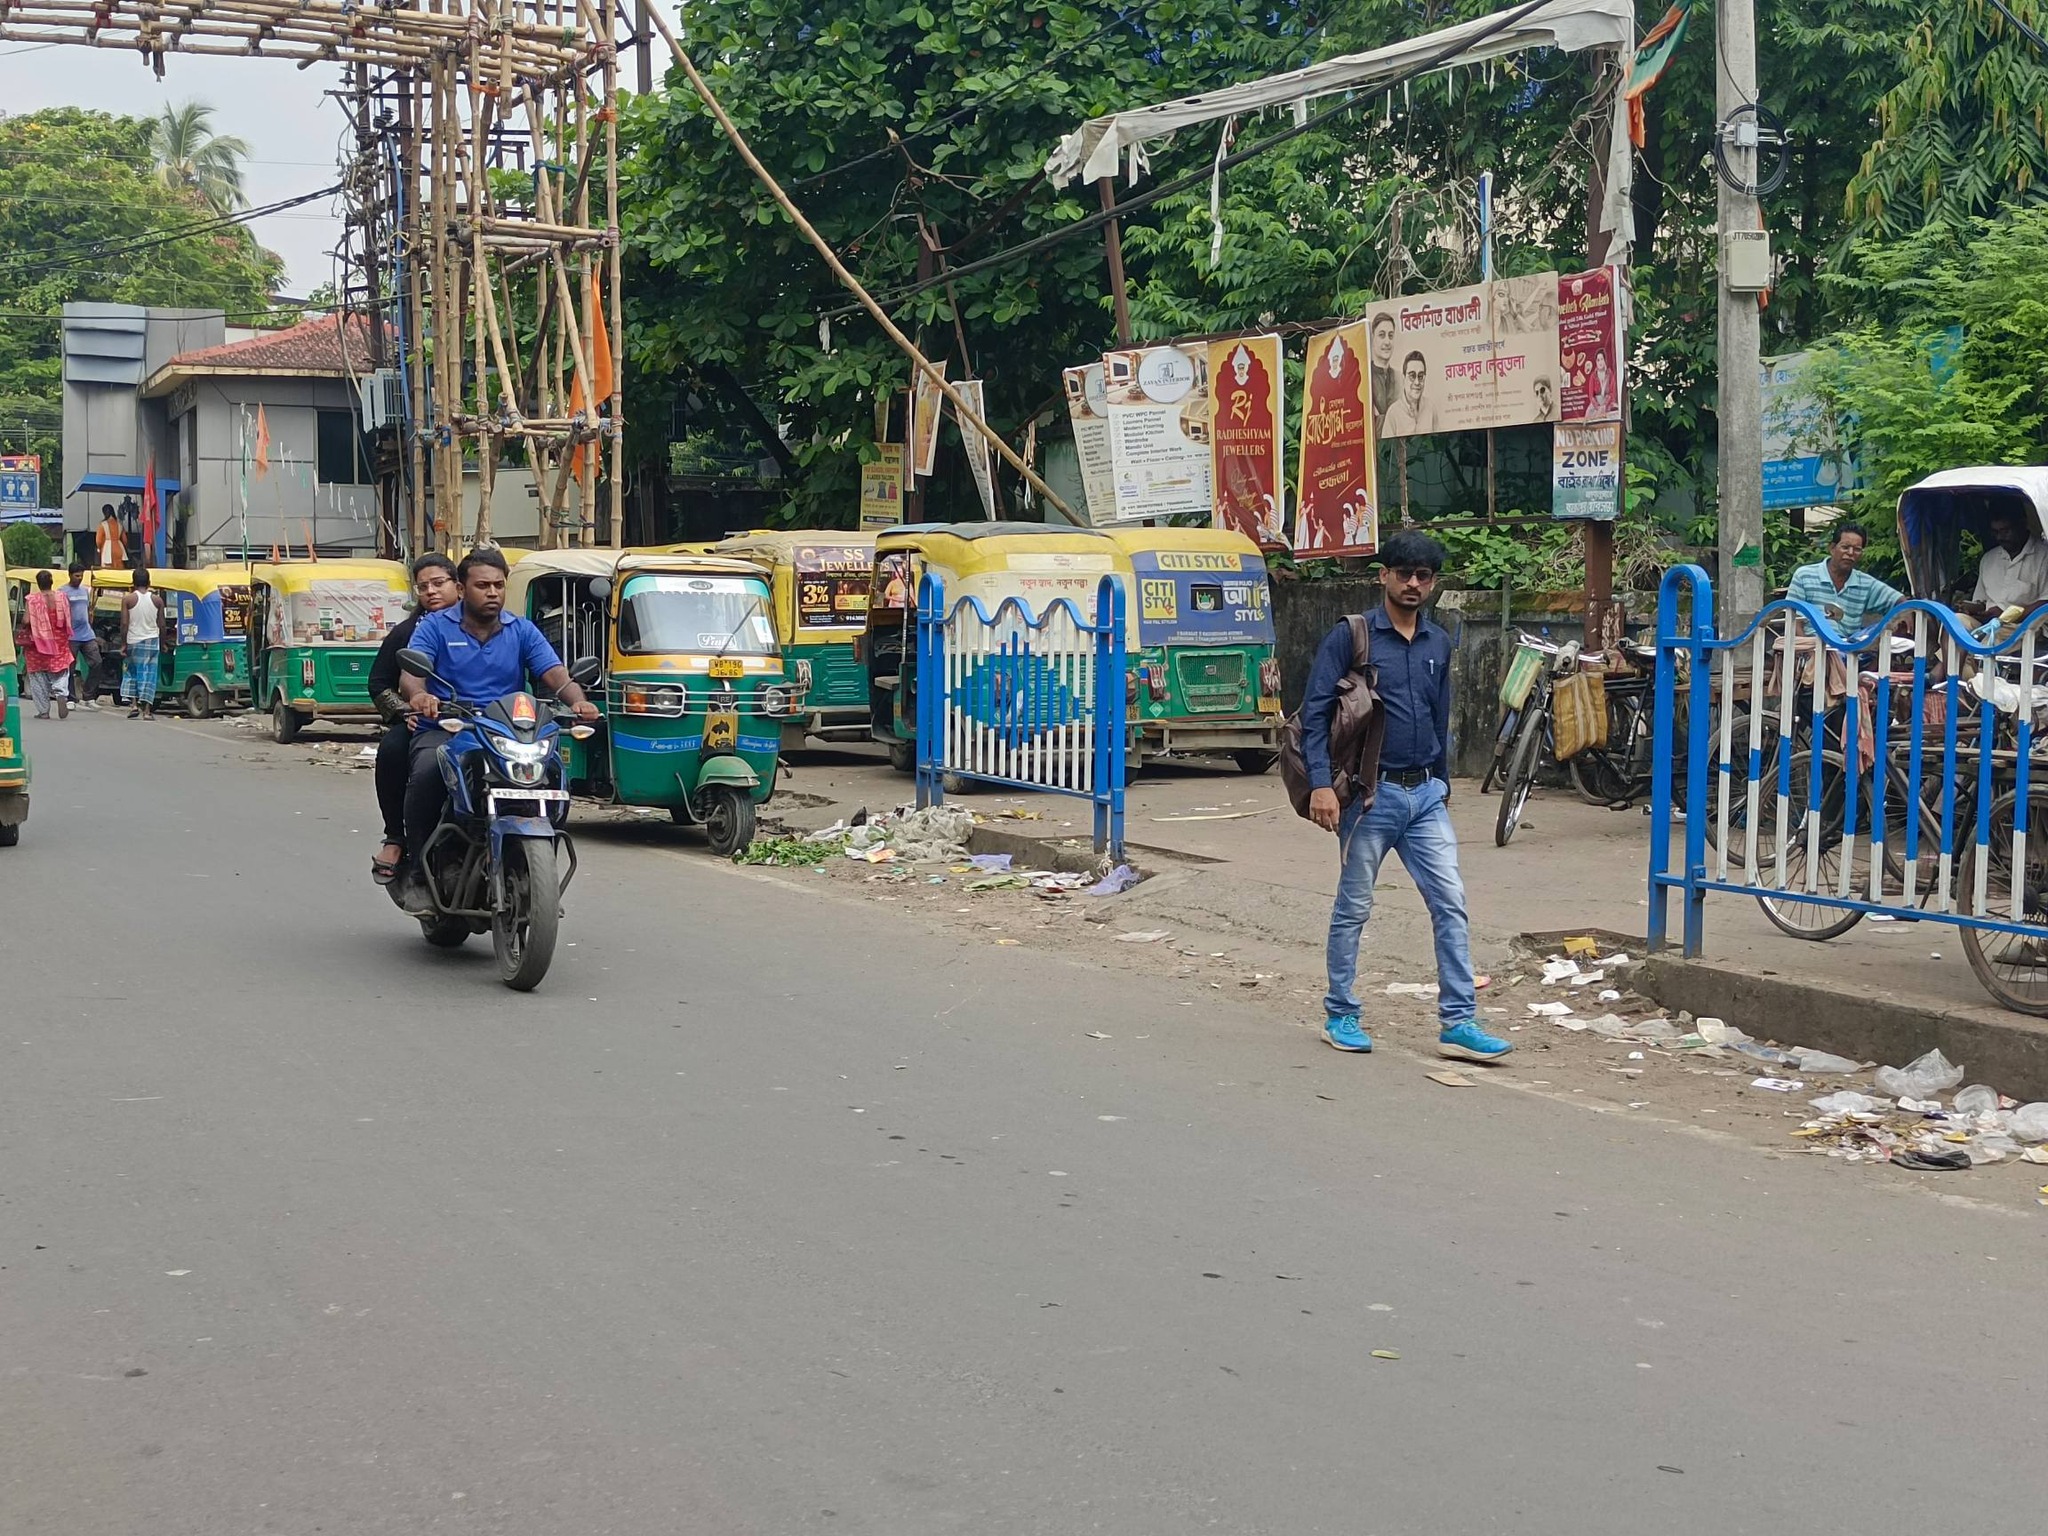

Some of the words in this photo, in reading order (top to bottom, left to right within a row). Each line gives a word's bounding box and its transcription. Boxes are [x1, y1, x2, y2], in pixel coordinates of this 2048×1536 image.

[1400, 308, 1442, 331] বিকশিত
[1445, 361, 1482, 380] রাজপুর
[1486, 355, 1525, 377] লেবুতলা
[1162, 376, 1190, 384] INTERIOR
[1216, 428, 1272, 441] RADHESHYAM
[1222, 444, 1266, 458] JEWELLERS
[1562, 450, 1609, 469] ZONE
[843, 548, 864, 560] SS
[1160, 554, 1191, 567] CITI
[1194, 554, 1238, 568] STYLE
[1056, 578, 1073, 590] নতুন
[1143, 581, 1174, 597] CITI
[803, 584, 829, 605] 3%
[1144, 596, 1175, 615] STYLE
[224, 609, 241, 623] 3%
[1234, 608, 1265, 621] STYLE
